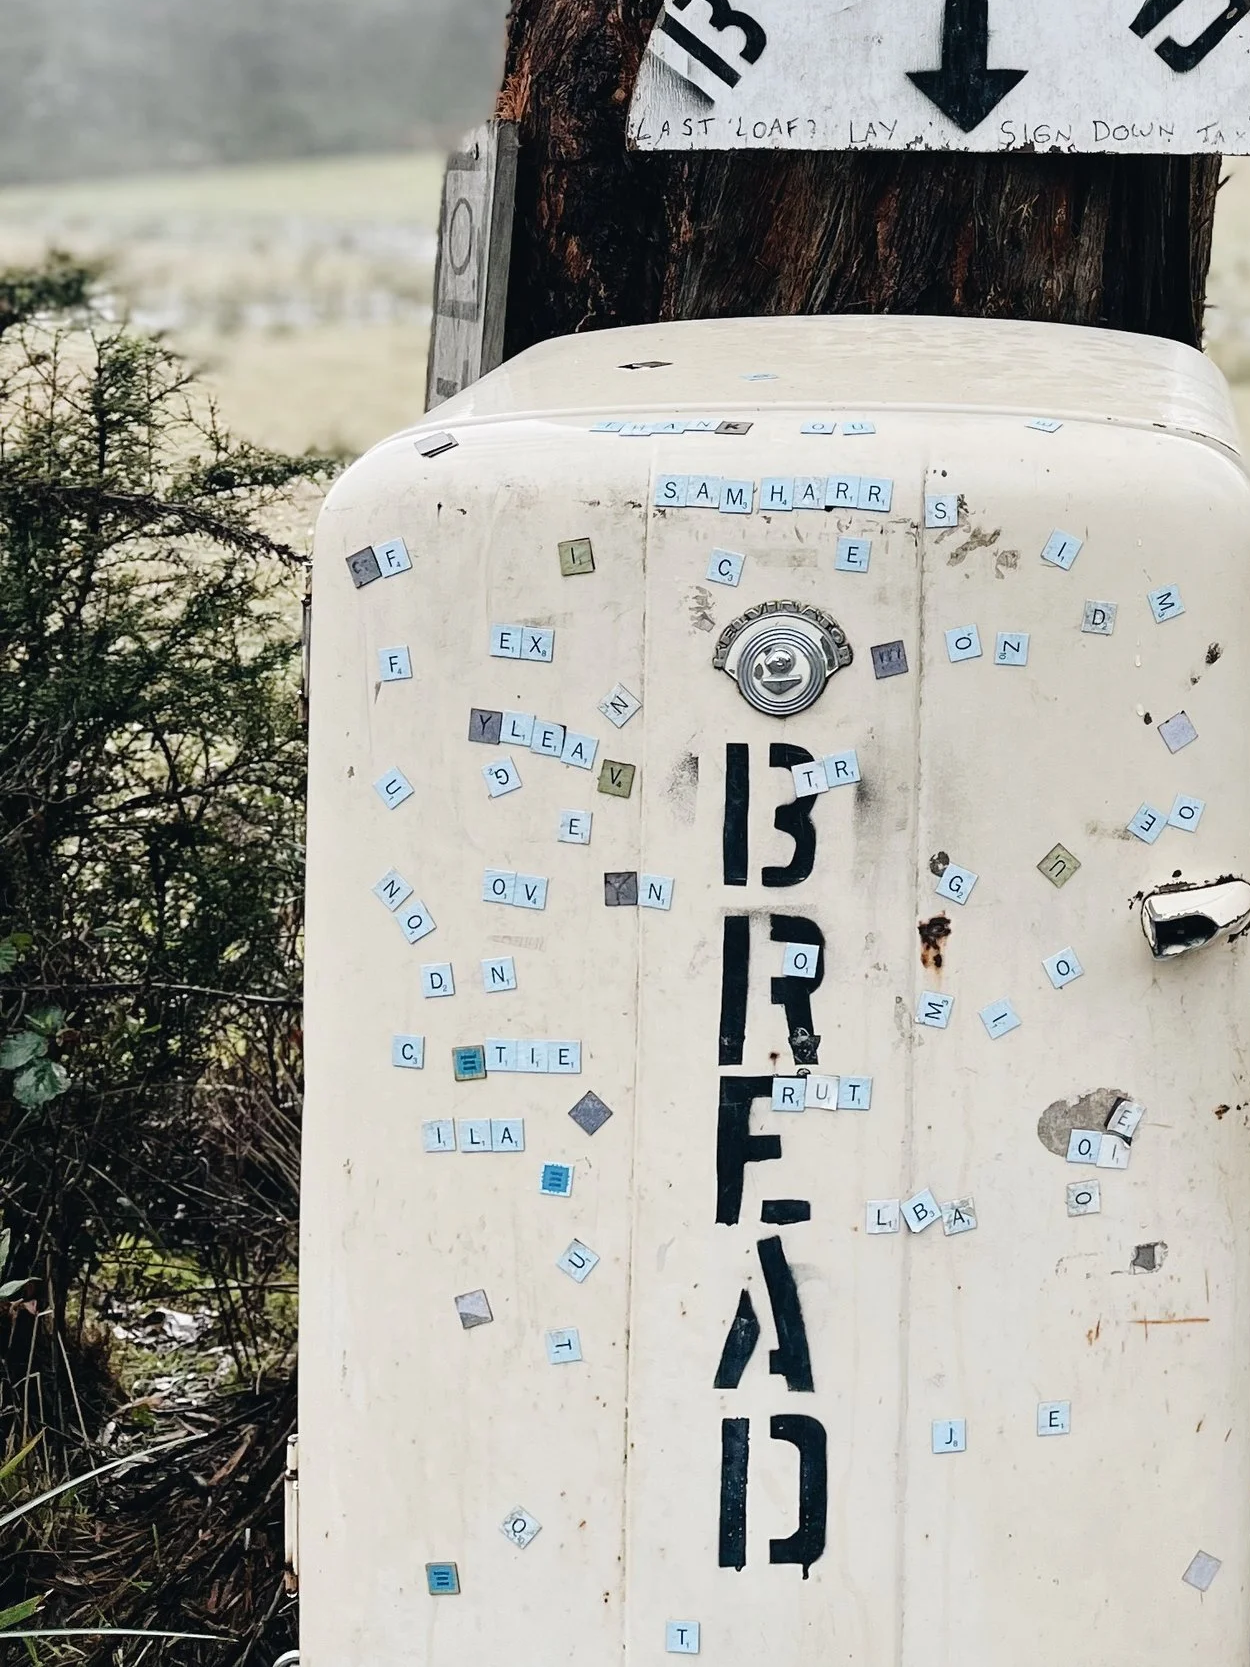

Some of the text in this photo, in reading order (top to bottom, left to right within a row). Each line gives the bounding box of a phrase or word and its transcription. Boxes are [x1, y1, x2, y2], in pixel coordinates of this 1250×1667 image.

[1000, 119, 1072, 145] SIGN
[1092, 119, 1175, 142] DOWN
[711, 742, 828, 1571] BREAD
